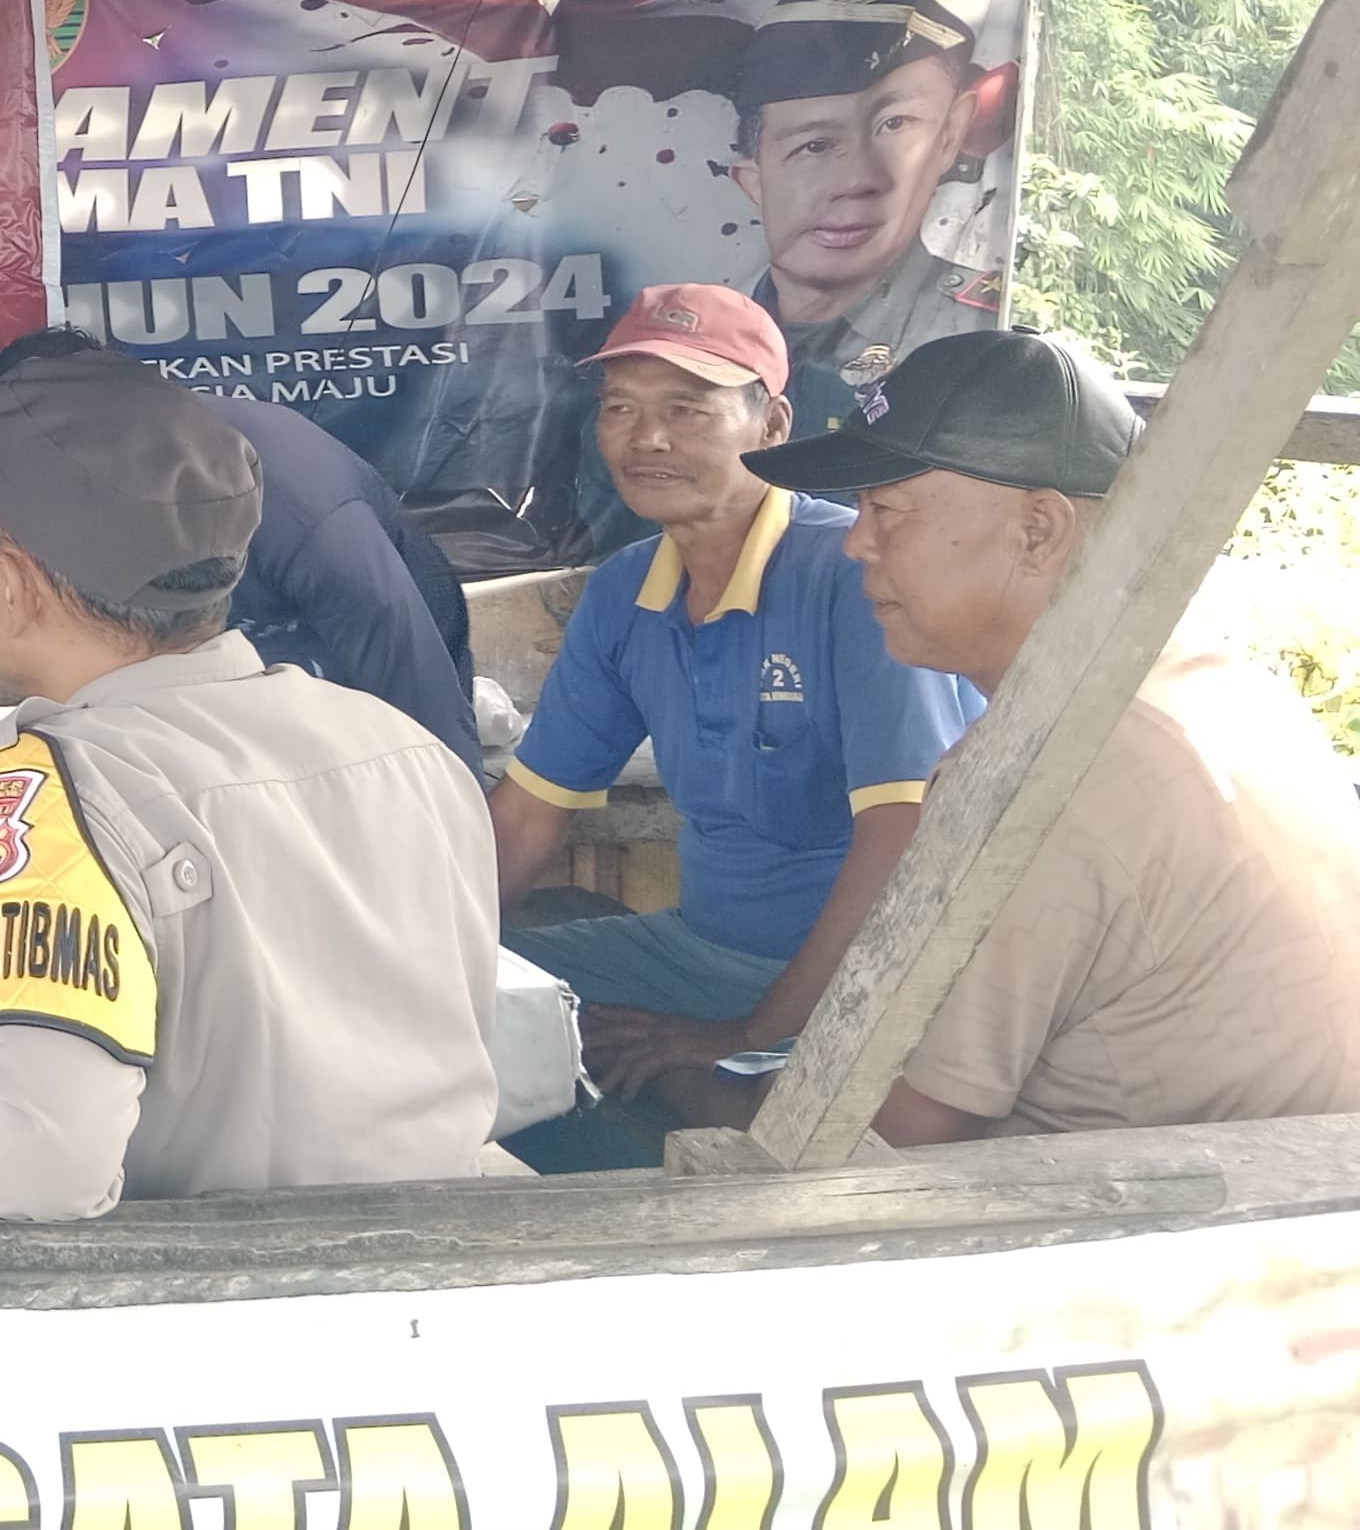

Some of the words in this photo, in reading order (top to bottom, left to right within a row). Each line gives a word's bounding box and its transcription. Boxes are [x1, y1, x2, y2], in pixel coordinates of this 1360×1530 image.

[227, 150, 427, 224] TNI
[297, 254, 612, 336] 2024
[265, 342, 471, 374] PRESTASI
[271, 374, 397, 404] MAJU
[772, 669, 785, 687] 2
[547, 1360, 1164, 1530] ALAM
